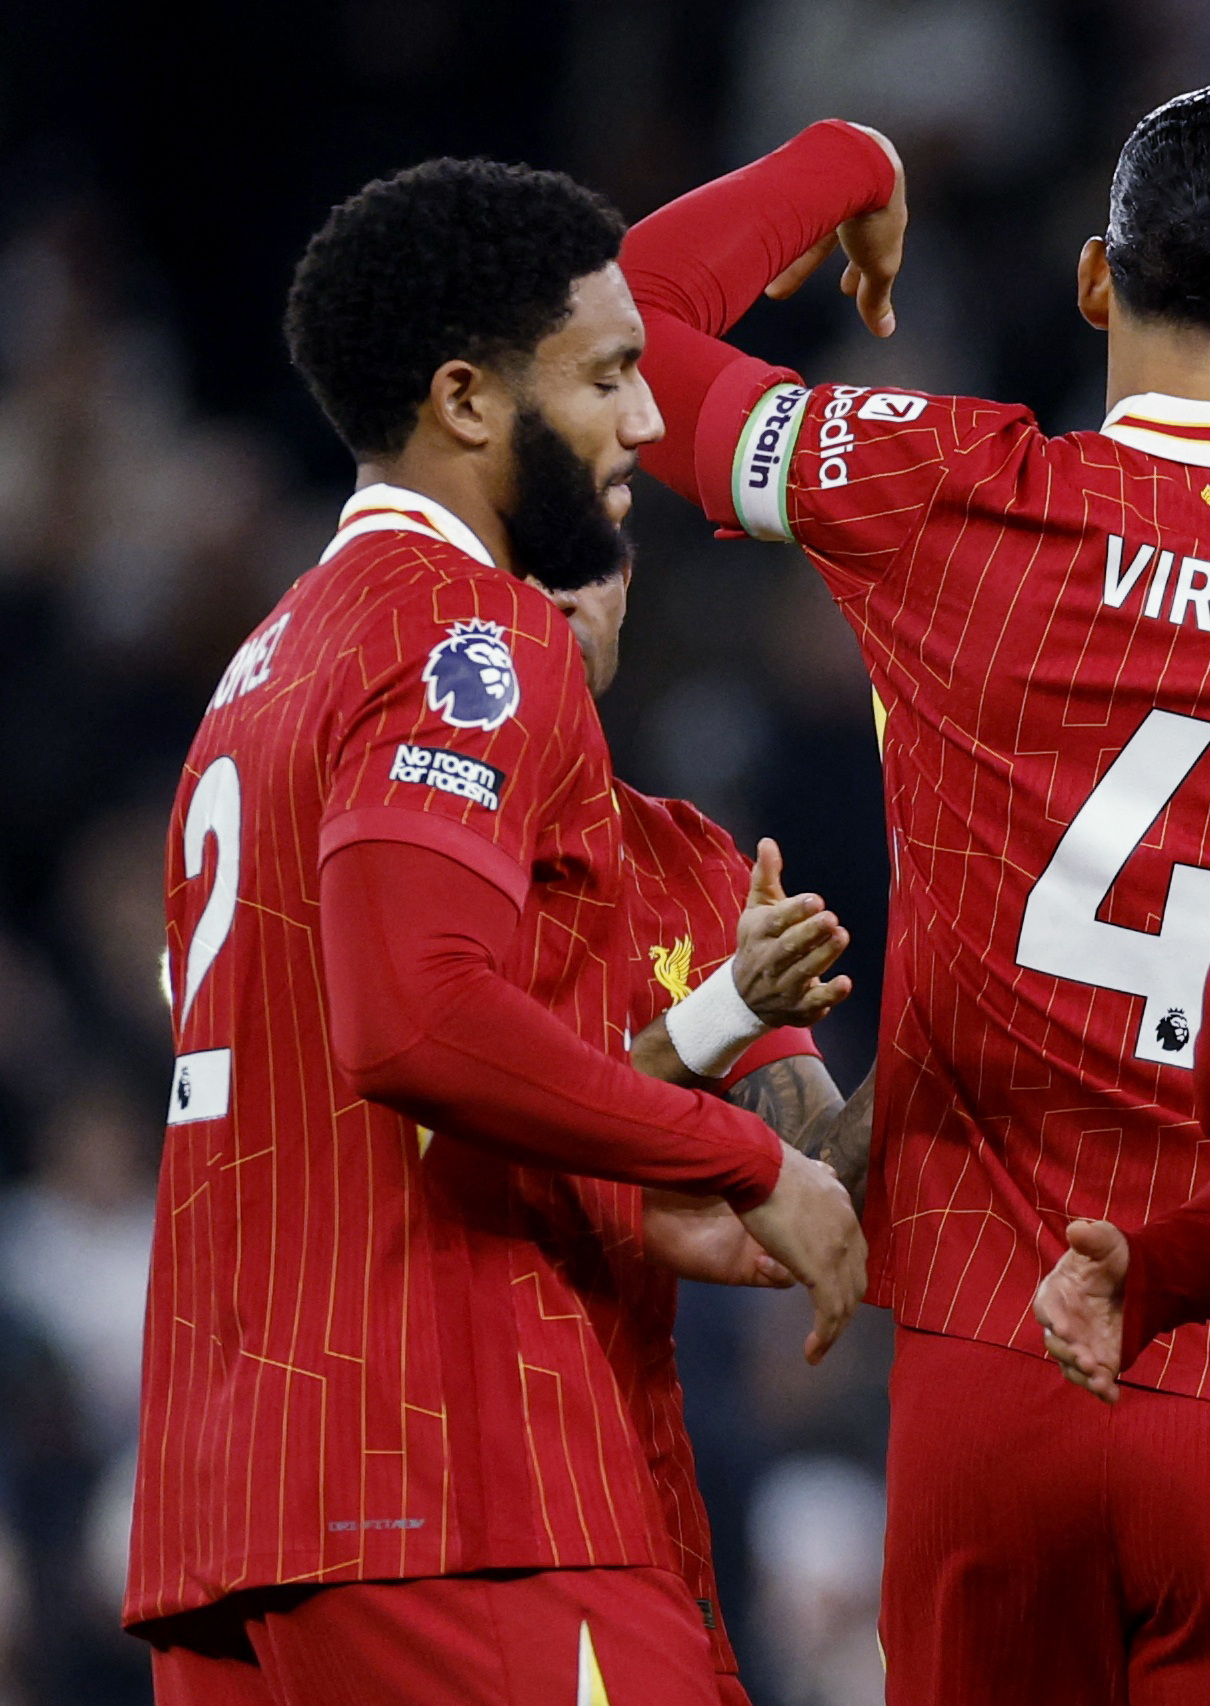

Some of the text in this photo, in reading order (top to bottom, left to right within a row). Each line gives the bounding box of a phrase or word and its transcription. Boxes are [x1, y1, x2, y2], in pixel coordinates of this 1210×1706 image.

[204, 612, 292, 716] OMEZ
[389, 761, 498, 811] for racism
[396, 744, 495, 789] No room
[167, 755, 241, 1126] 2
